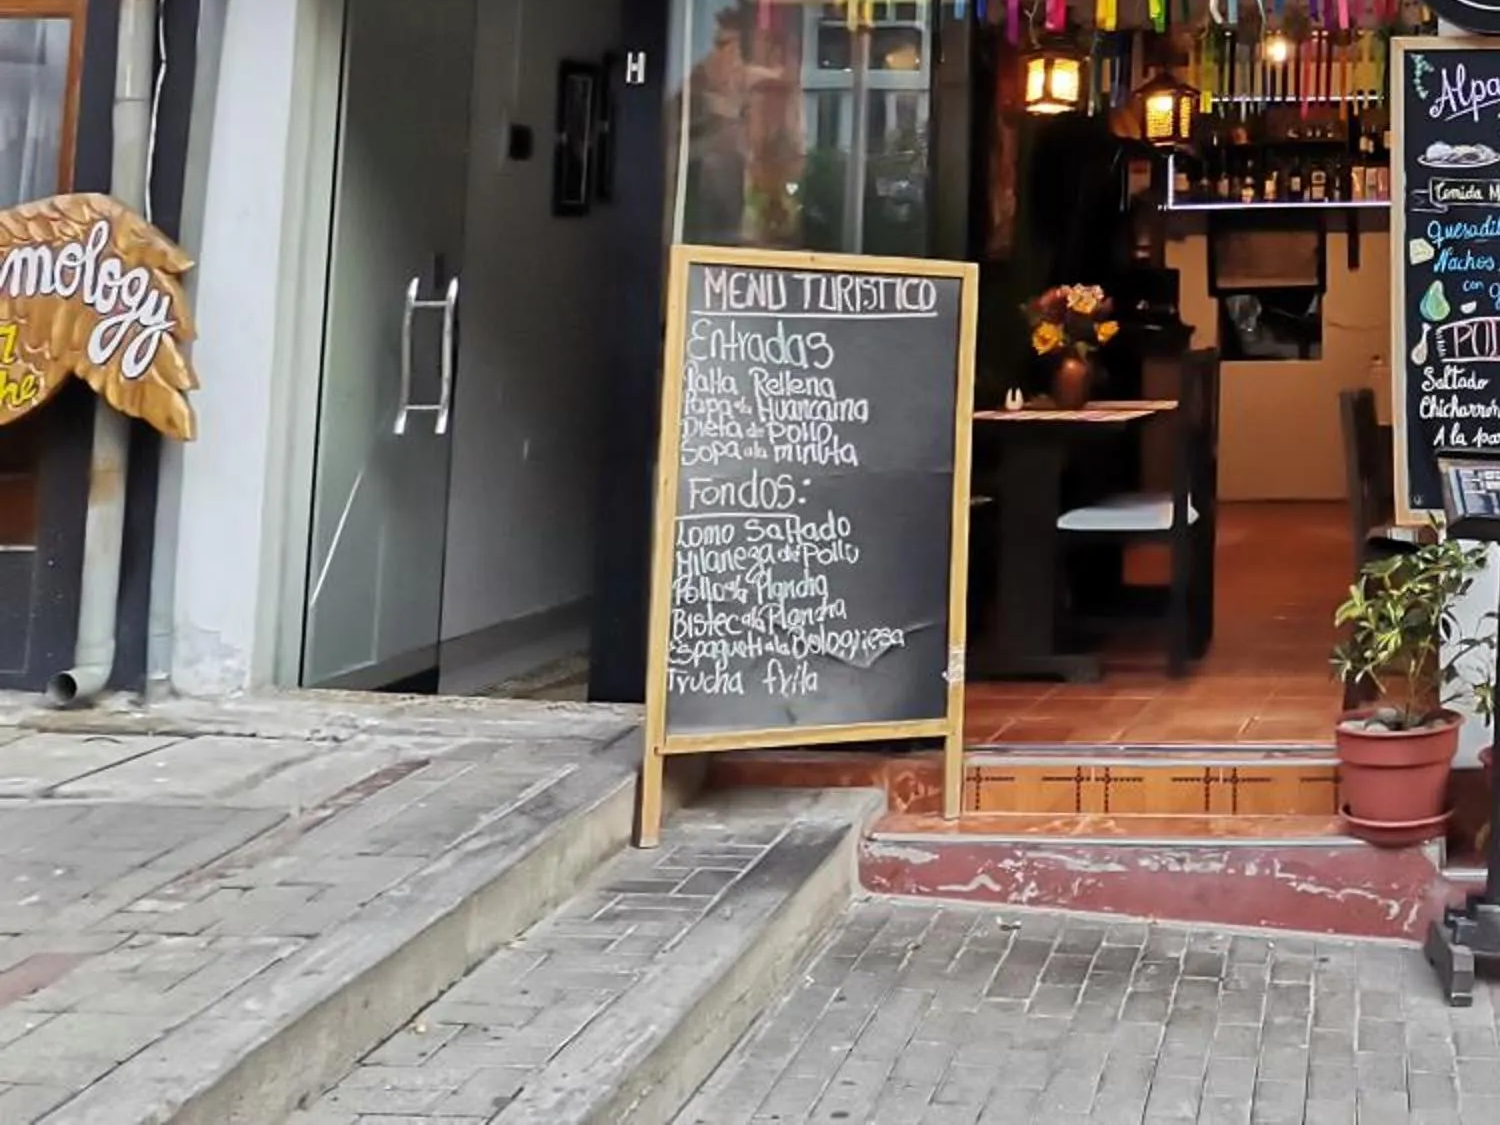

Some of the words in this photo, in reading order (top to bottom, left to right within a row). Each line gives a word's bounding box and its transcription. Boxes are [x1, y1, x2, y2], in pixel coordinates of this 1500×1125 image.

[703, 266, 788, 312] MENU
[686, 317, 835, 370] Entradas
[748, 366, 837, 399] Rellena
